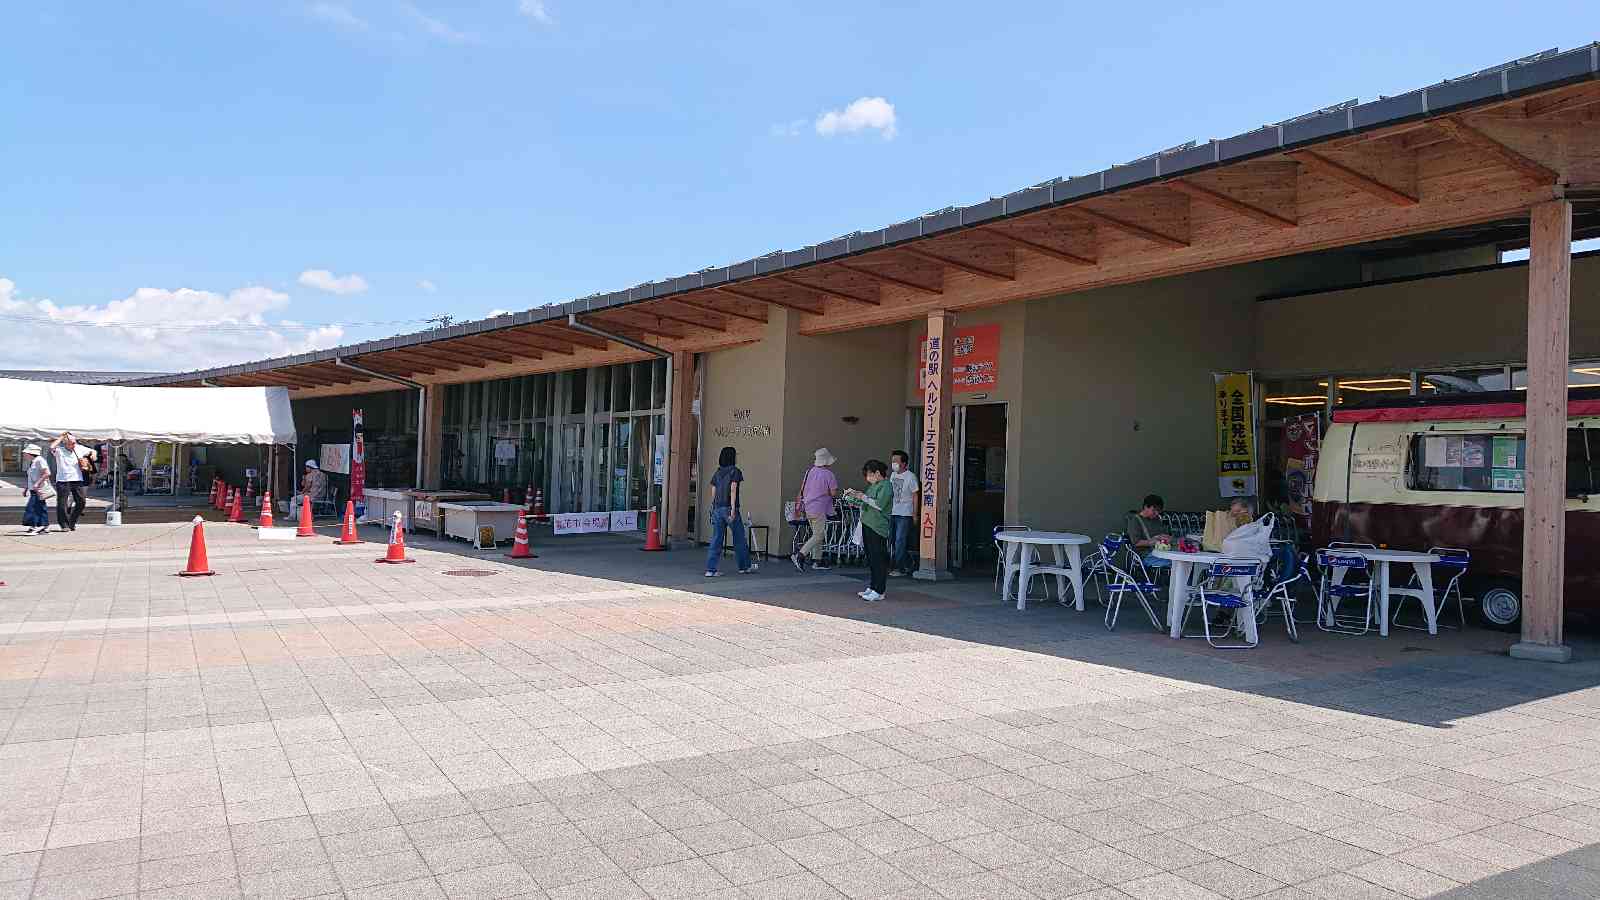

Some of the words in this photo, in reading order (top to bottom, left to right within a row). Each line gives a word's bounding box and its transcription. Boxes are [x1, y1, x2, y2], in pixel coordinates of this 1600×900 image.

[928, 336, 941, 376] 道の駅
[924, 380, 938, 508] ヘルシーテラス佐久南
[1231, 388, 1249, 456] 全国発送
[923, 512, 934, 539] 入口
